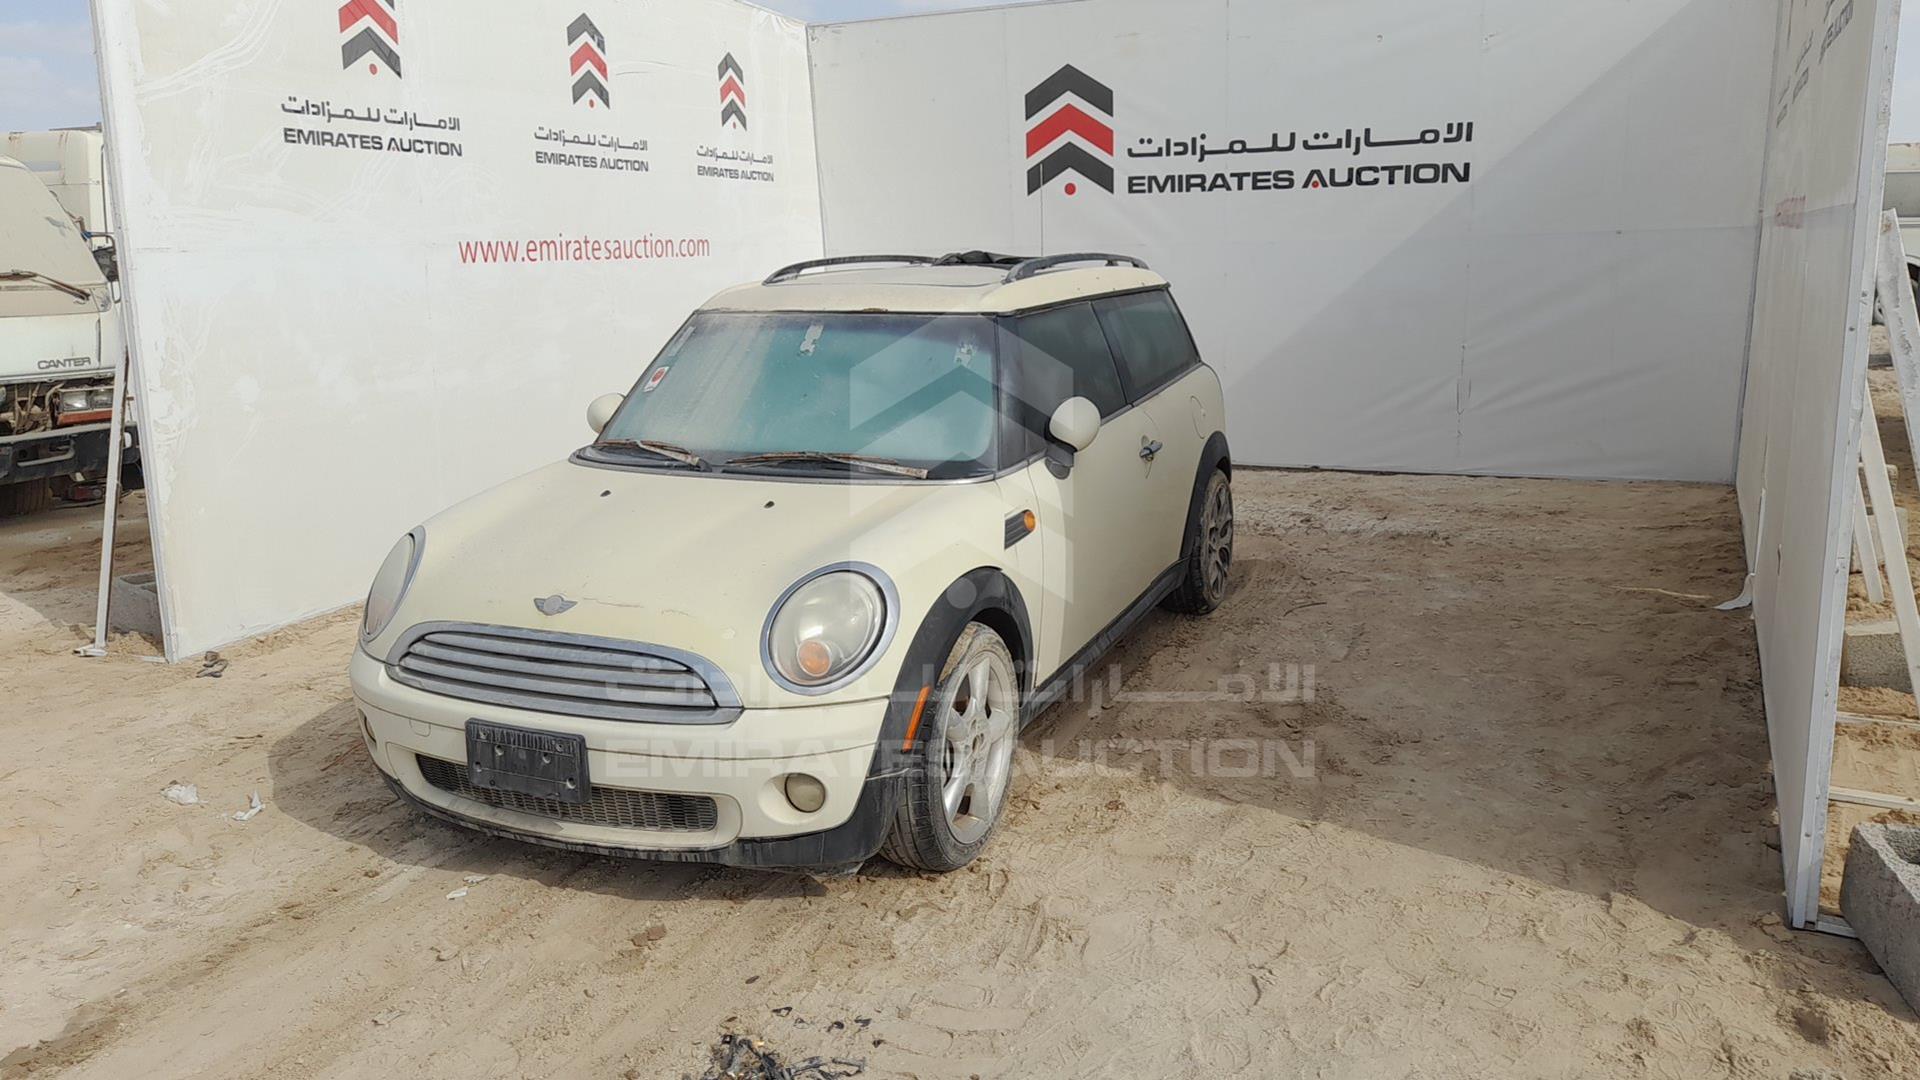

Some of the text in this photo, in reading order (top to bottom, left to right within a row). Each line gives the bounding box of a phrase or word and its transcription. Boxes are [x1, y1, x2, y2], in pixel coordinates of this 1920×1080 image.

[283, 127, 463, 156] EMIRATES AUCTION
[535, 150, 649, 172] EMIRATES AUCTION
[697, 165, 774, 182] EMIRATES AUCTION
[1127, 162, 1472, 194] EMIRATES AUCTION
[458, 232, 710, 264] www.emiratesauction.com
[37, 356, 92, 370] CANTER
